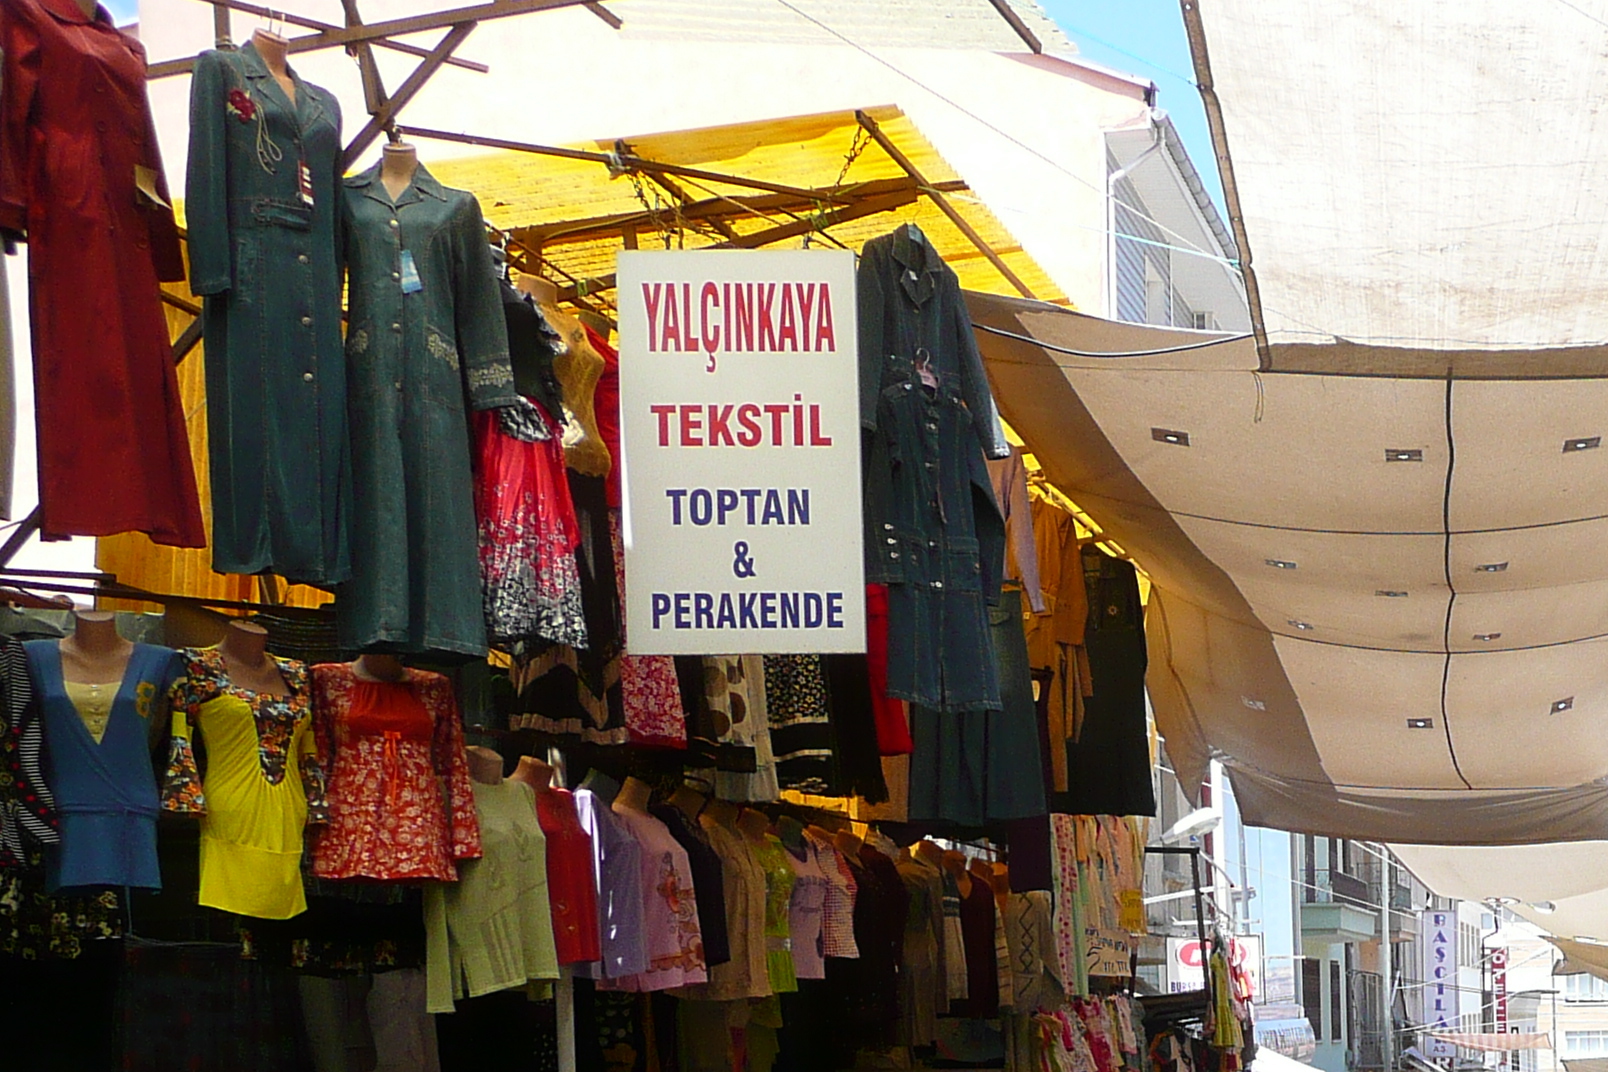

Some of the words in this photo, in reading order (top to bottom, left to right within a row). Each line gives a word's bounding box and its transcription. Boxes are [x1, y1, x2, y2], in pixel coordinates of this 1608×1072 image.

[641, 281, 836, 373] YALÇINKAYA
[650, 393, 832, 447] TEKSTİL
[666, 488, 810, 526] TOPTAN
[732, 540, 756, 579] &
[652, 592, 844, 630] PERAKENDE
